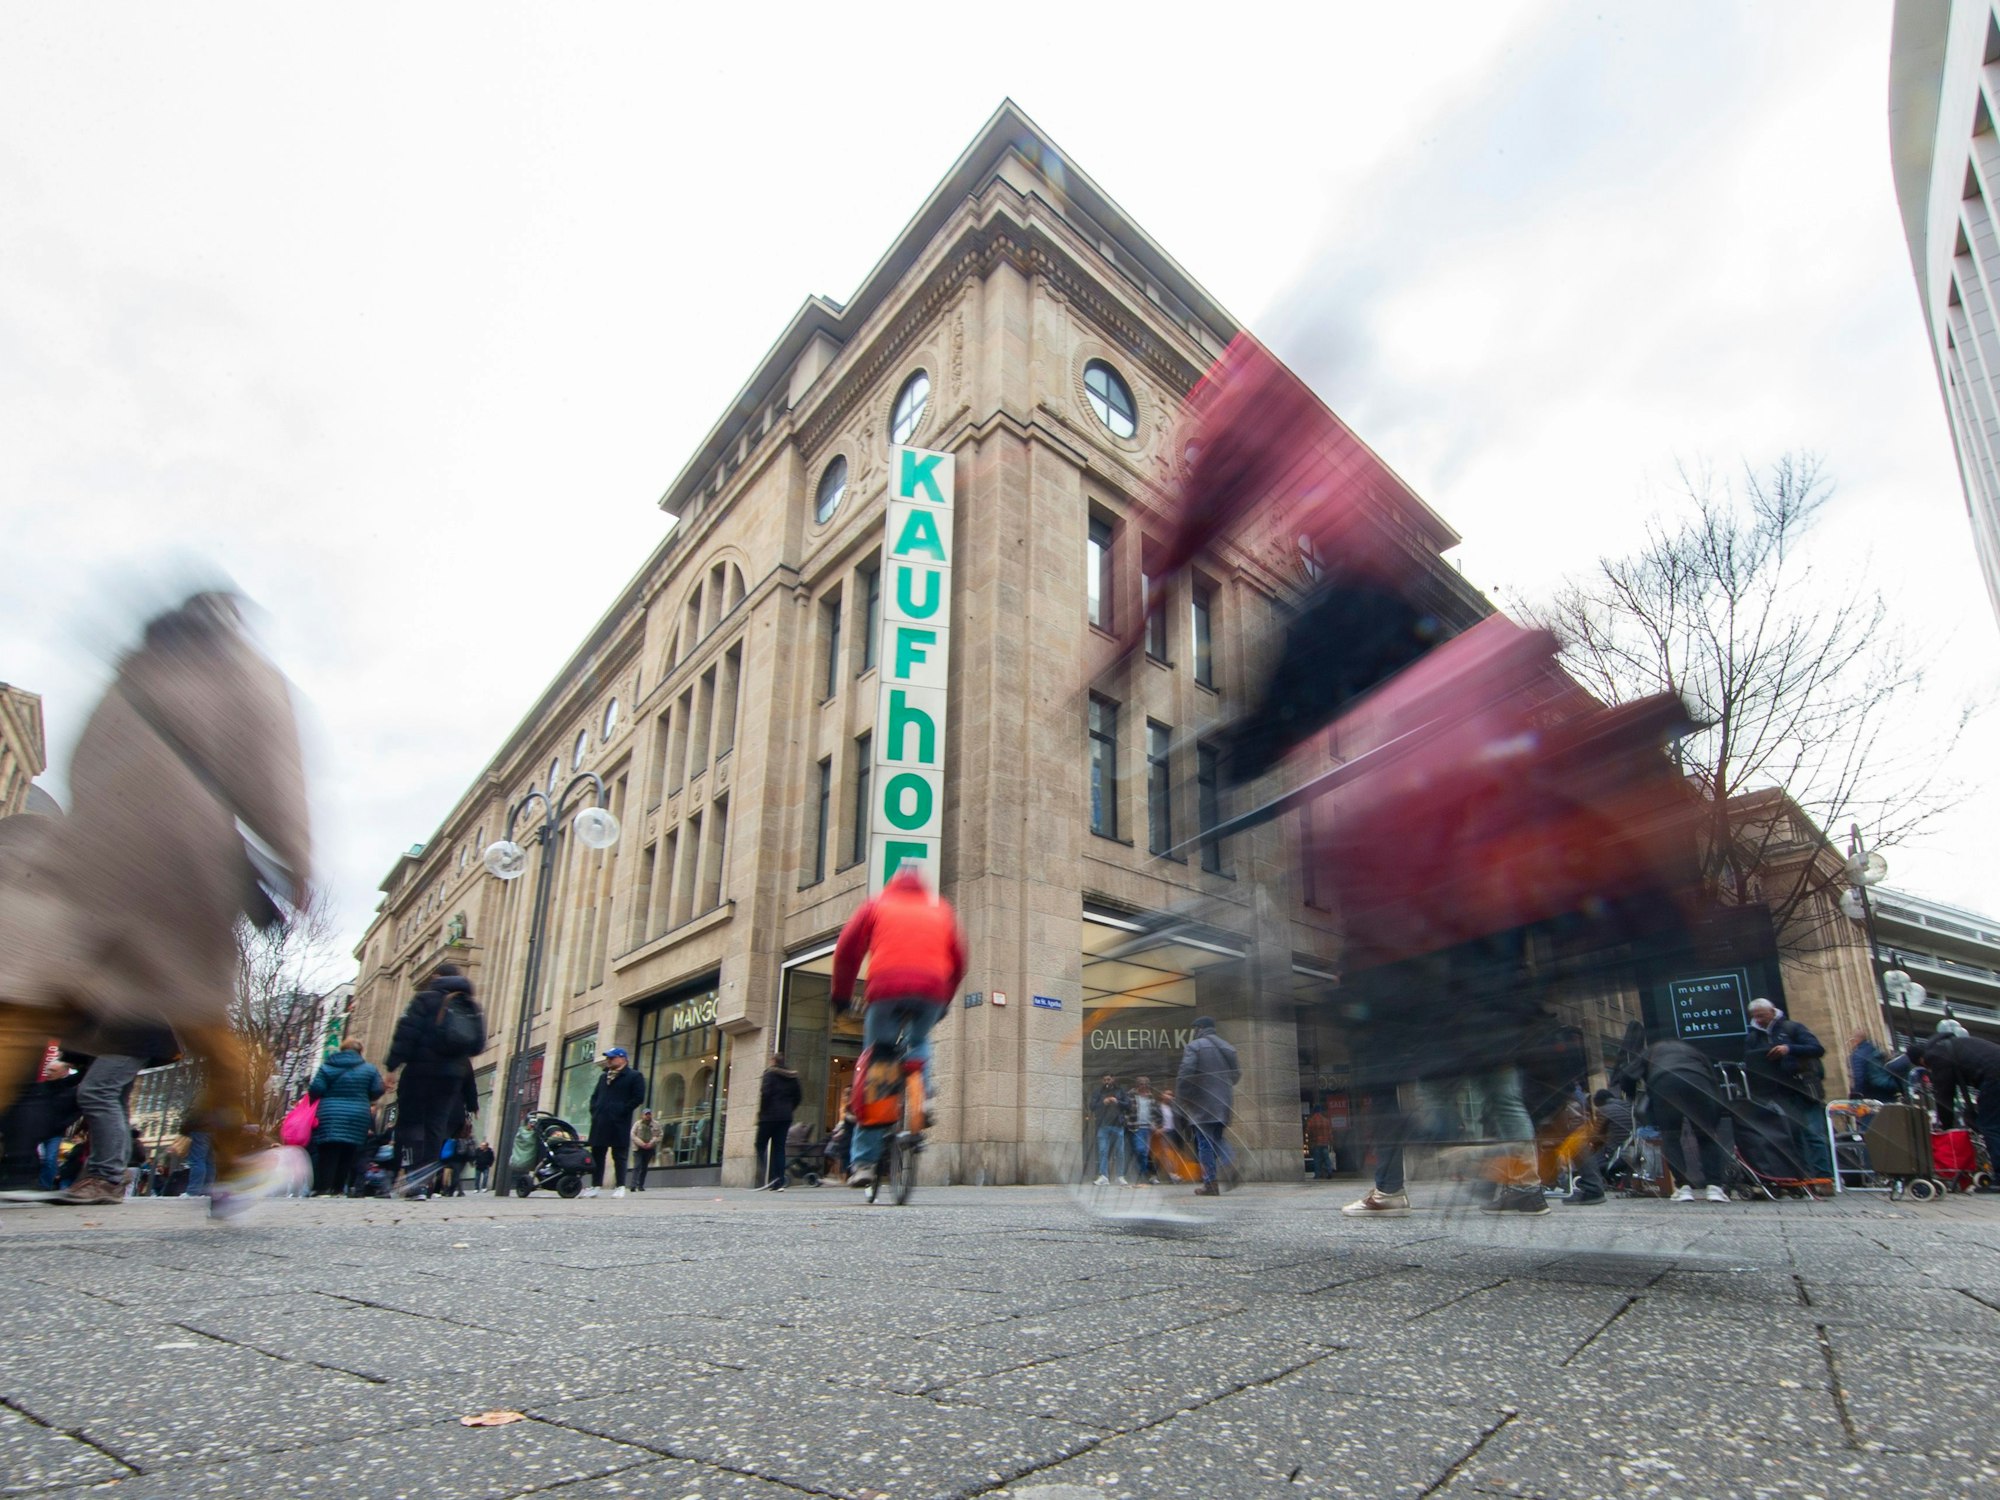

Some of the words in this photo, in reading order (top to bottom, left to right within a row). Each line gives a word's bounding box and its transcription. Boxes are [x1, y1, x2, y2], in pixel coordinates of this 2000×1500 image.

[1678, 981, 1731, 994] museum
[1680, 997, 1693, 1007] of
[1682, 1008, 1732, 1019] modern
[1685, 1022, 1720, 1032] ahrts
[1090, 1029, 1172, 1050] GALERIA
